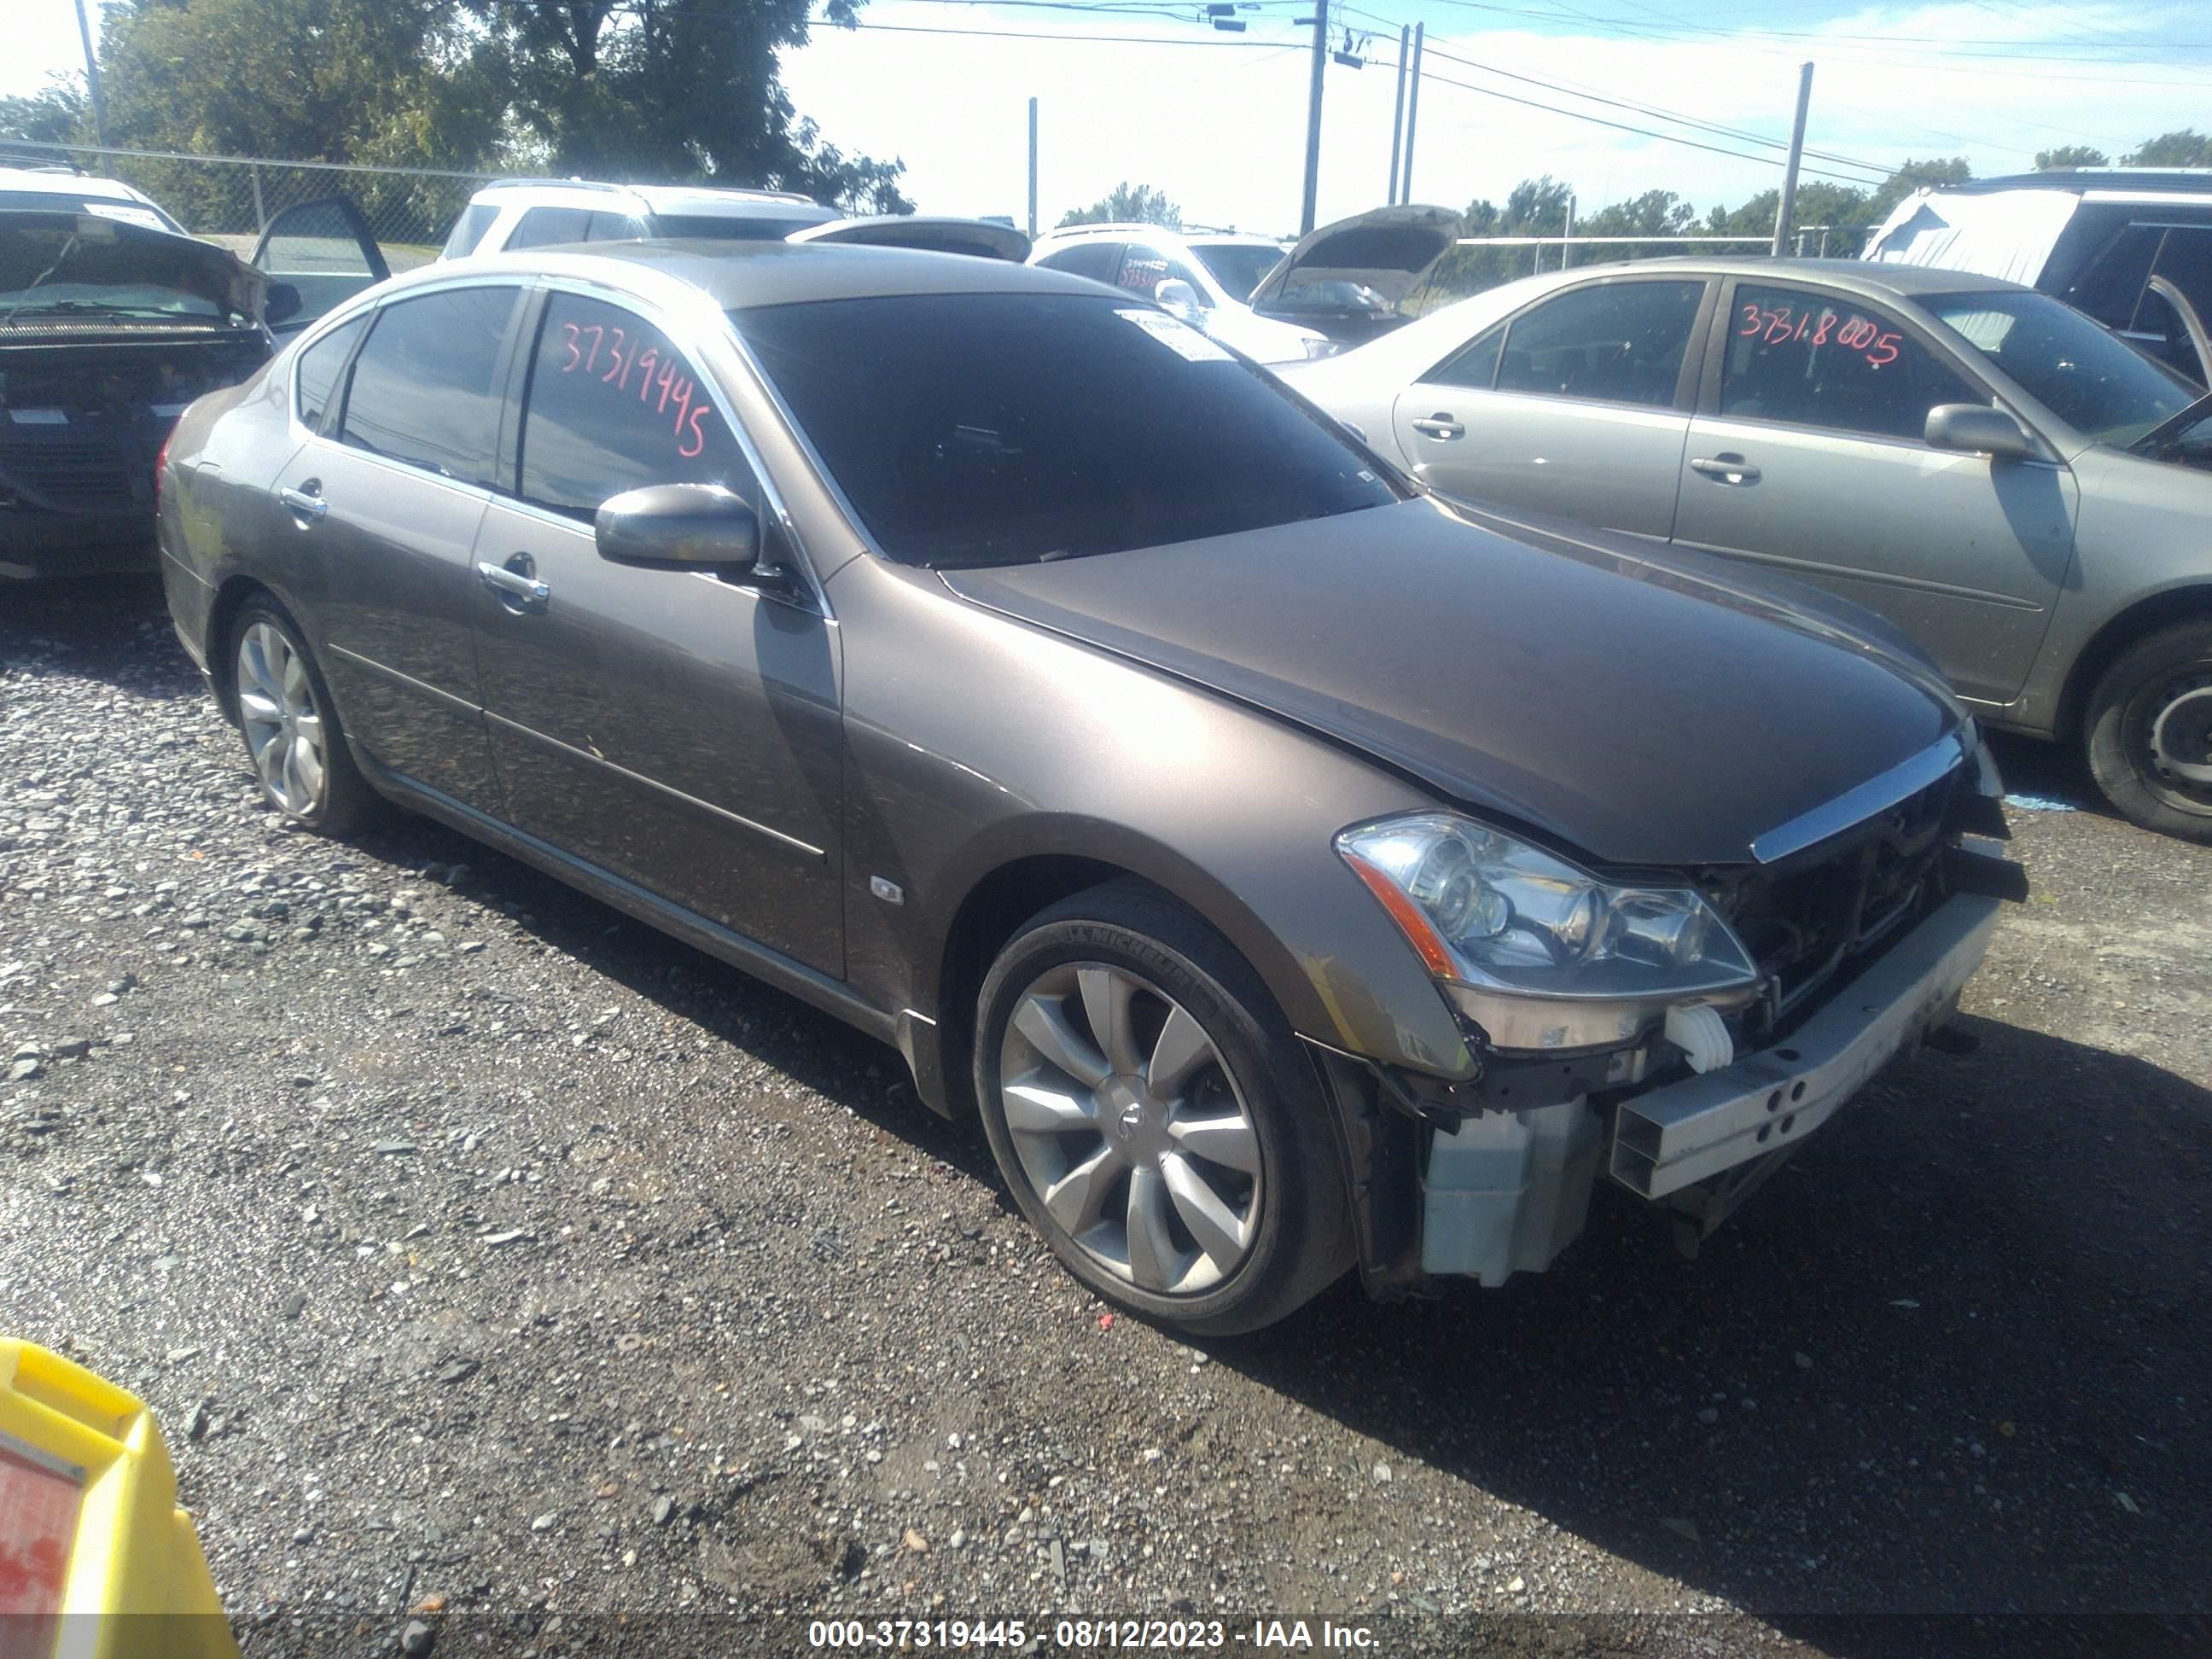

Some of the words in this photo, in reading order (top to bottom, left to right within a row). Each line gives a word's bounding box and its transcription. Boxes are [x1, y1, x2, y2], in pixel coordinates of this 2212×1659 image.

[1741, 305, 1903, 364] 37318005
[562, 323, 710, 457] 37319445
[1091, 927, 1191, 992] MICHELIN
